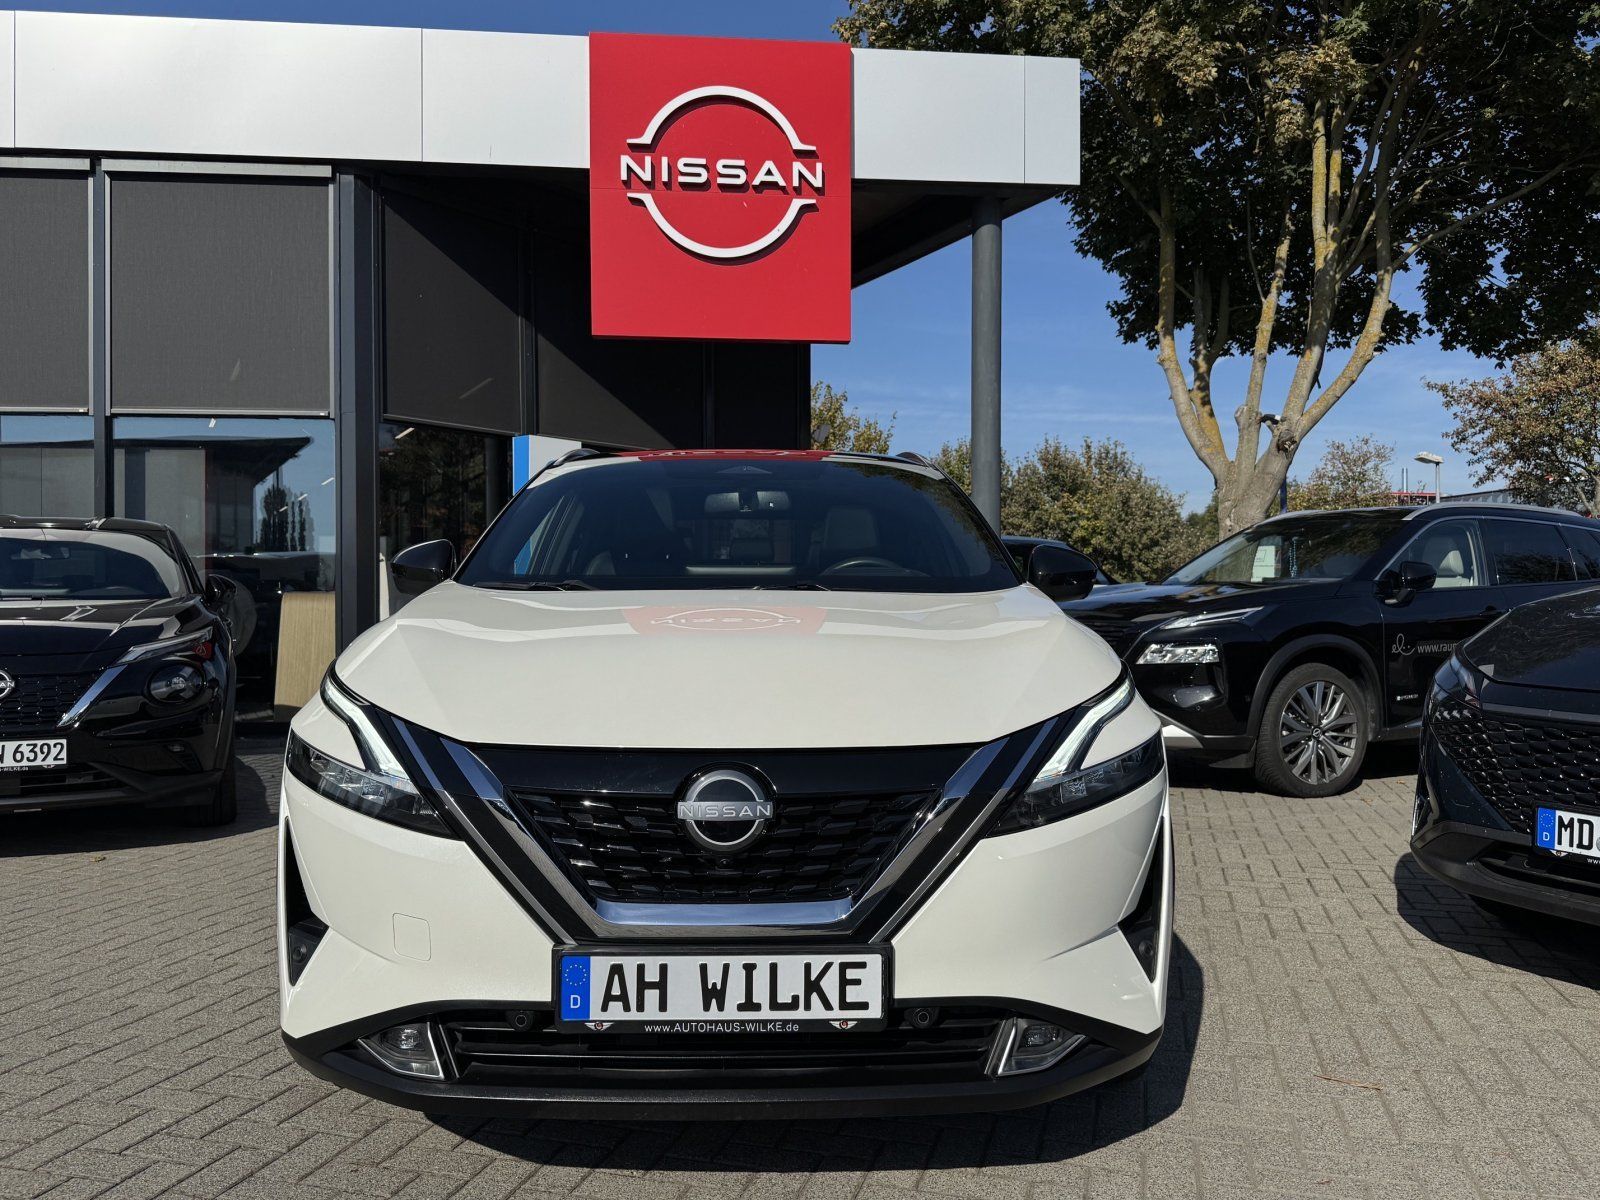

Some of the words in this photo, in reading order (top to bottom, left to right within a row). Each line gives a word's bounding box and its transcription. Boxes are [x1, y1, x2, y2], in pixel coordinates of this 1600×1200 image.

[620, 154, 824, 192] NISSAN
[1417, 643, 1456, 654] www.rau
[12, 742, 65, 763] 6392
[680, 804, 771, 818] NISSAN
[1543, 831, 1550, 841] D
[1557, 815, 1594, 850] MD
[600, 962, 668, 1012] AH
[699, 961, 869, 1012] WILKE
[570, 995, 580, 1009] D
[644, 1021, 799, 1033] www.AUTOHAUS-WILKE.de
